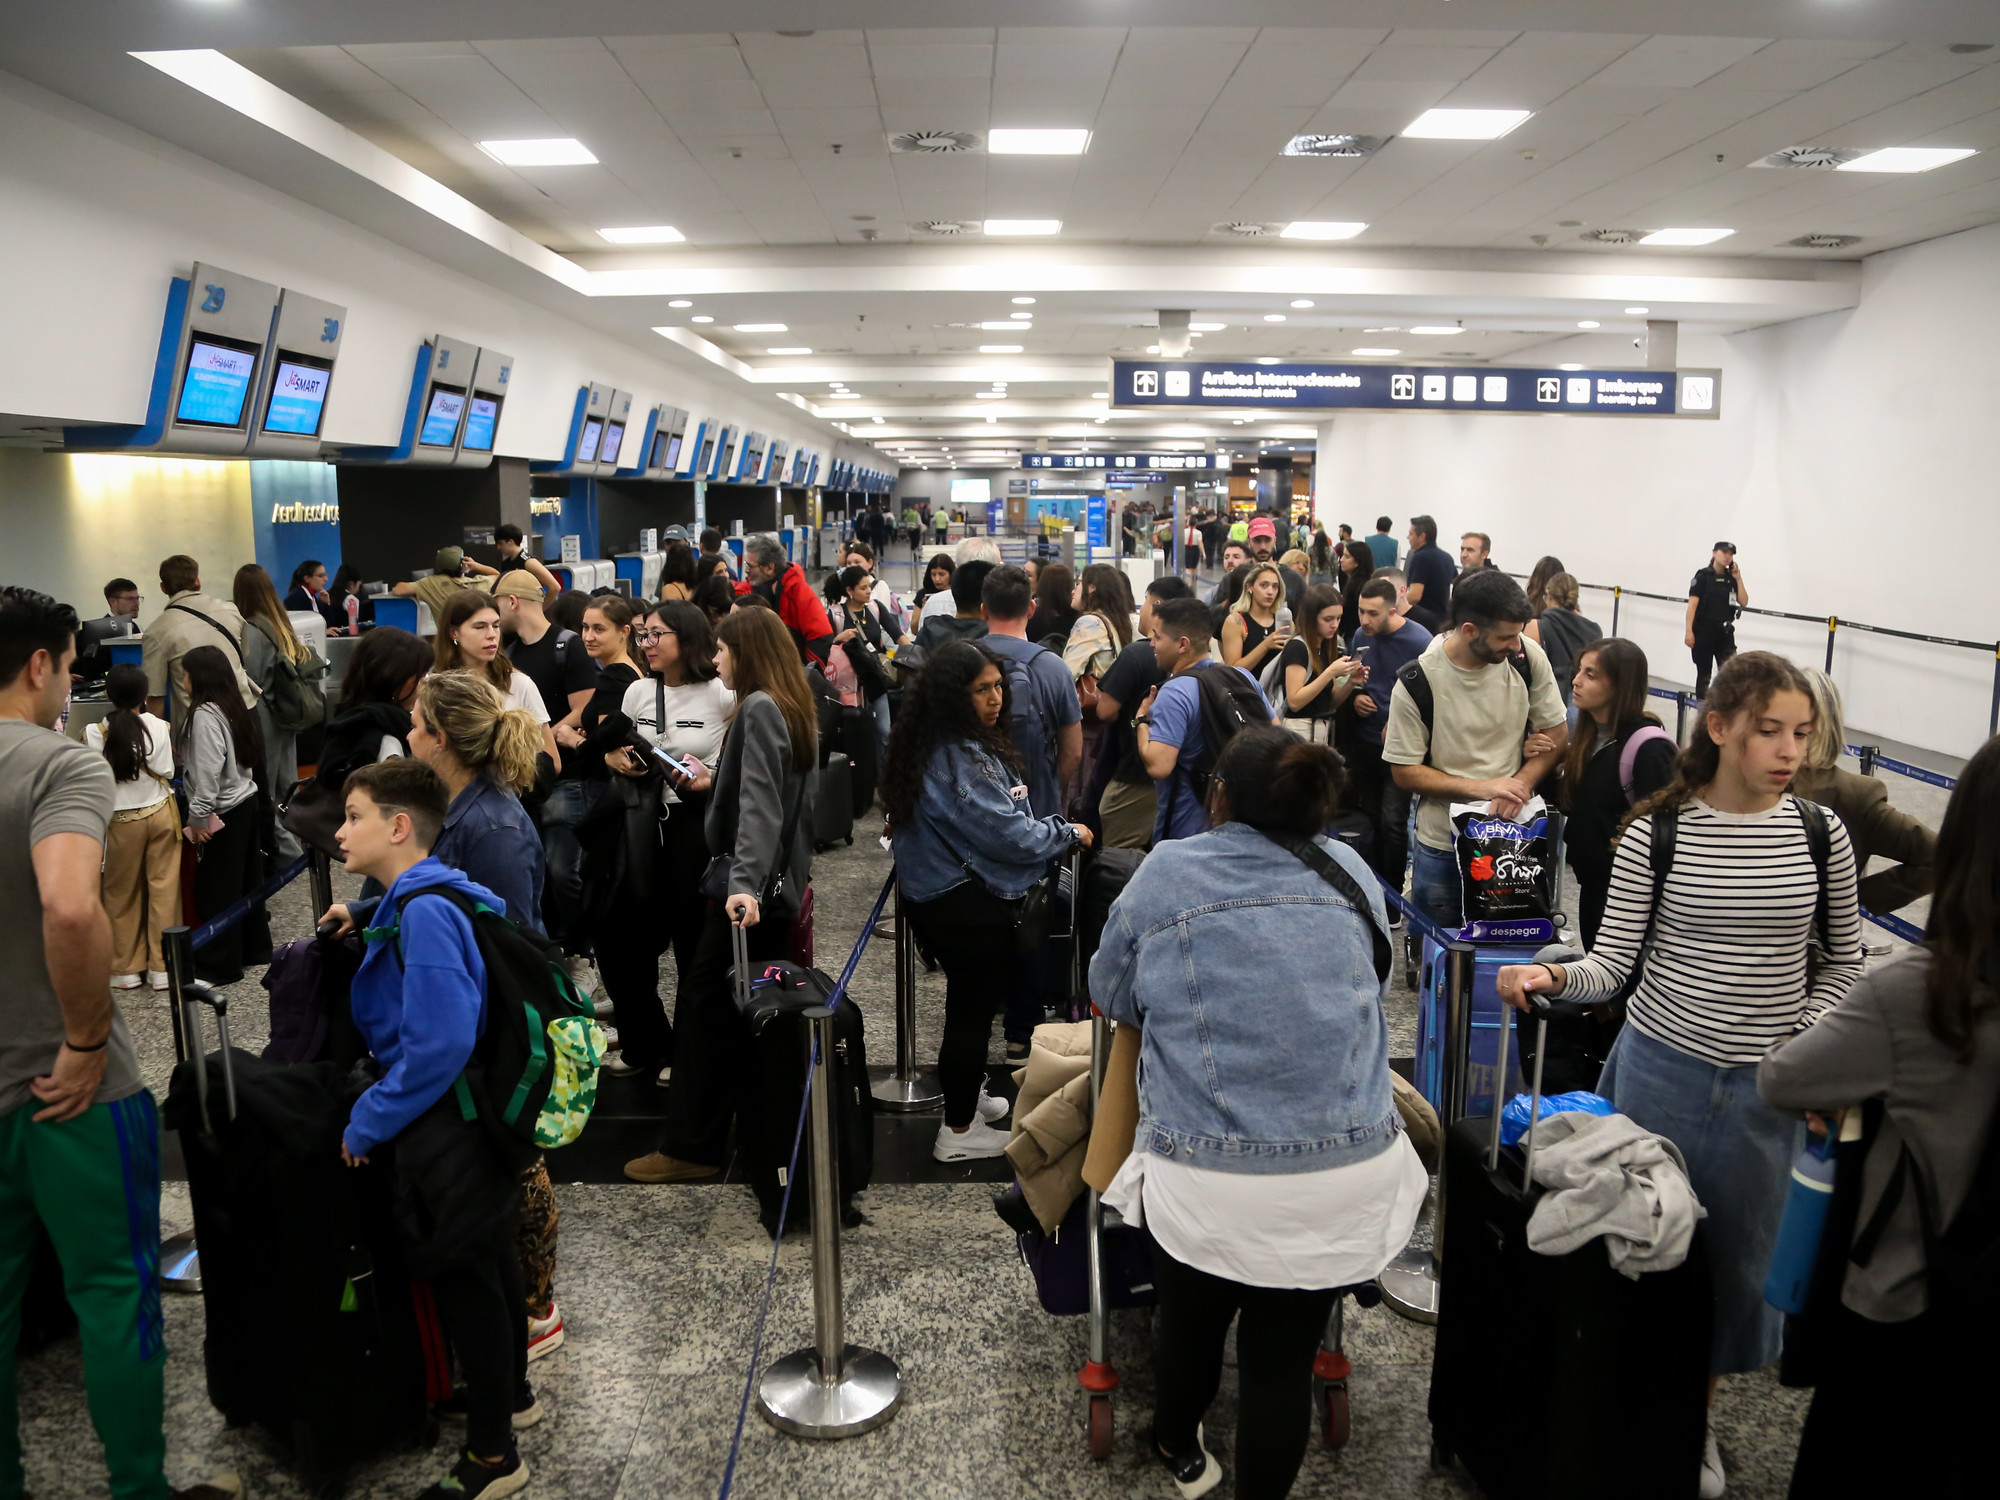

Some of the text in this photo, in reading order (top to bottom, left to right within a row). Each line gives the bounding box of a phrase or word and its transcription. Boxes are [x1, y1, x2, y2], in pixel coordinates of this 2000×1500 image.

[201, 284, 226, 313] 29
[320, 318, 339, 344] 30
[284, 370, 321, 394] JetSMART
[1202, 371, 1254, 386] Arribos
[1202, 387, 1298, 399] International arrivals
[1597, 378, 1664, 396] Embarque
[1597, 393, 1657, 407] Boarding area
[1490, 926, 1541, 937] despegar
